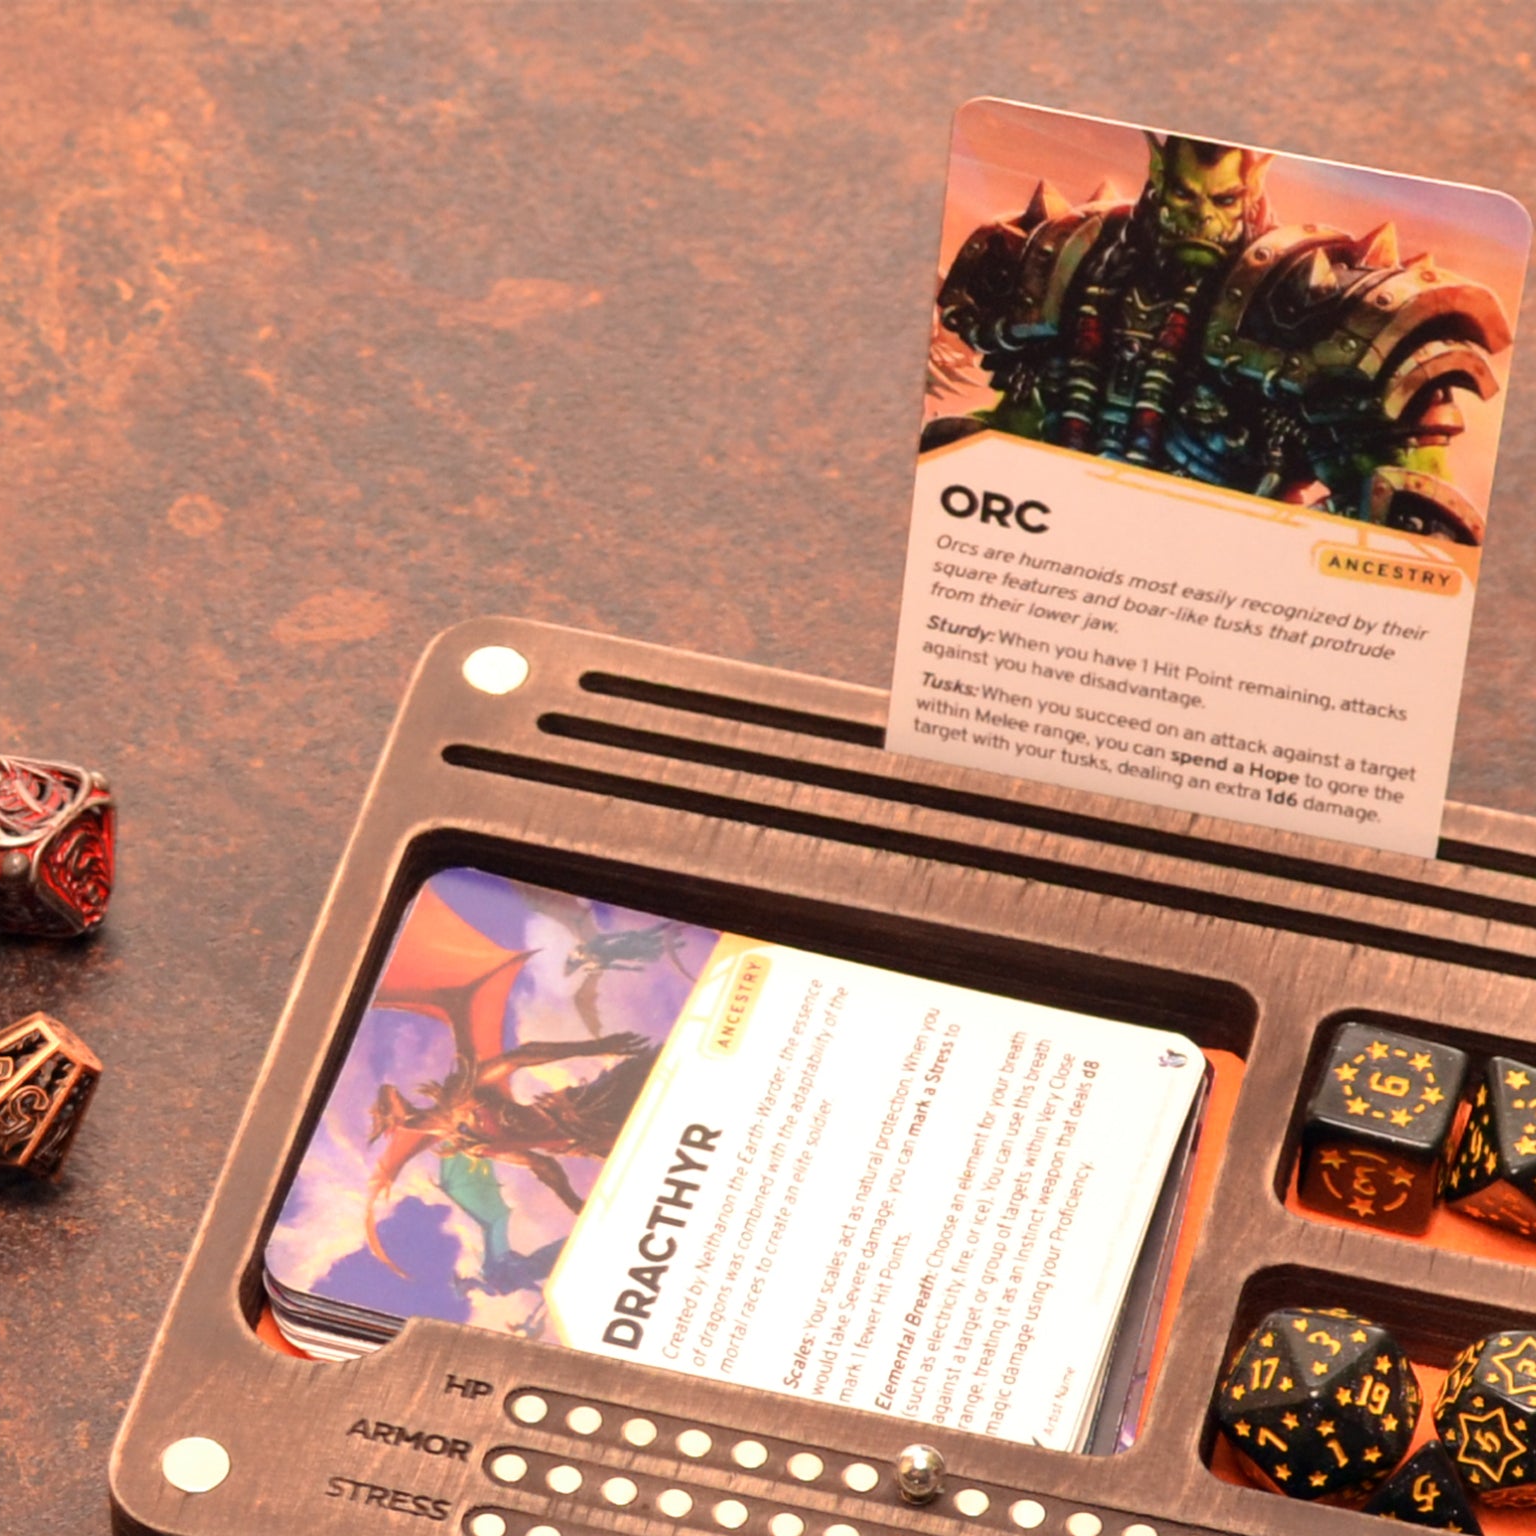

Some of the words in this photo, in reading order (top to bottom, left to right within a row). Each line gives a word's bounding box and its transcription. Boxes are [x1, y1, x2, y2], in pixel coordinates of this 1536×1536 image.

[939, 485, 1051, 534] ORC
[937, 534, 980, 557] Orcs
[982, 547, 1016, 564] are
[1018, 551, 1125, 586] humanoids
[1127, 576, 1179, 597] most
[1181, 586, 1238, 610] easily
[1239, 597, 1352, 628] recognized
[1352, 615, 1379, 636] by
[1381, 620, 1430, 641] their
[1326, 555, 1453, 589] ANCESTRY
[930, 581, 976, 604] from
[978, 592, 1026, 613] their
[1027, 602, 1082, 625] lower
[1080, 613, 1119, 634] jaw.
[932, 561, 998, 585] square
[1001, 571, 1079, 601] features
[1081, 592, 1122, 609] and
[1122, 596, 1209, 626] boar-like
[1213, 614, 1264, 637] tusks
[1268, 624, 1309, 645] that
[1309, 635, 1396, 661] protrude
[922, 641, 989, 666] against
[993, 656, 1027, 673] you
[1031, 660, 1076, 683] have
[1079, 671, 1206, 710] disadvantage.
[925, 614, 997, 645] Sturdy:
[998, 629, 1050, 654] When
[1055, 644, 1089, 662] you
[1092, 648, 1137, 671] have
[1142, 658, 1149, 673] 1
[1153, 660, 1181, 680] Hit
[1185, 665, 1234, 690] Point
[1237, 680, 1336, 712] remaining,
[1339, 698, 1408, 722] attacks
[922, 670, 980, 698] Tusks:
[981, 684, 1033, 709] When
[1037, 699, 1071, 717] you
[1075, 706, 1152, 733] succeed
[1155, 722, 1179, 738] on
[1182, 728, 1206, 743] an
[1209, 732, 1268, 755] attack
[1271, 745, 1341, 769] against
[1343, 758, 1356, 772] a
[1359, 758, 1417, 783] target
[913, 717, 968, 743] target
[972, 732, 1010, 751] with
[1015, 742, 1057, 760] your
[1060, 747, 1112, 774] tusks,
[1116, 760, 1184, 790] dealing
[1187, 776, 1211, 791] an
[1214, 781, 1261, 801] extra
[1265, 787, 1299, 808] 1d6
[1302, 795, 1381, 824] damage.
[916, 697, 971, 720] within
[974, 706, 1030, 733] Melee
[1033, 723, 1090, 747] range,
[1095, 735, 1129, 753] you
[1132, 743, 1166, 760] can
[1170, 750, 1229, 772] spend
[1232, 762, 1245, 775] a
[1248, 761, 1301, 786] Hope
[1303, 772, 1324, 790] to
[1326, 780, 1370, 798] gore
[1373, 784, 1405, 804] the
[717, 957, 763, 1049] ANCESTRY
[920, 1007, 941, 1033] you
[942, 1023, 961, 1038] to
[997, 1030, 1028, 1074] breath
[901, 1034, 929, 1073] When
[923, 1040, 955, 1084] Stress
[922, 1086, 937, 1097] a
[988, 1075, 1010, 1108] your
[907, 1099, 933, 1138] mark
[976, 1110, 997, 1130] for
[897, 1138, 917, 1166] can
[956, 1132, 990, 1192] element
[855, 1151, 885, 1203] natural
[886, 1167, 907, 1194] you
[847, 1205, 865, 1222] as
[950, 1192, 967, 1213] an
[601, 1121, 721, 1352] DRACTHYR
[838, 1223, 859, 1248] act
[925, 1214, 960, 1269] Choose
[820, 1250, 848, 1295] scales
[837, 1261, 871, 1312] Severe
[802, 1297, 829, 1330] Your
[824, 1314, 852, 1347] take
[445, 1374, 494, 1401] HP
[811, 1349, 839, 1396] would
[873, 1327, 917, 1412] Elemental
[1250, 1356, 1280, 1392] 17
[1356, 1374, 1391, 1416] 19
[346, 1418, 472, 1462] ARMOR
[326, 1476, 453, 1522] STRESS
[1412, 1474, 1442, 1513] 4
